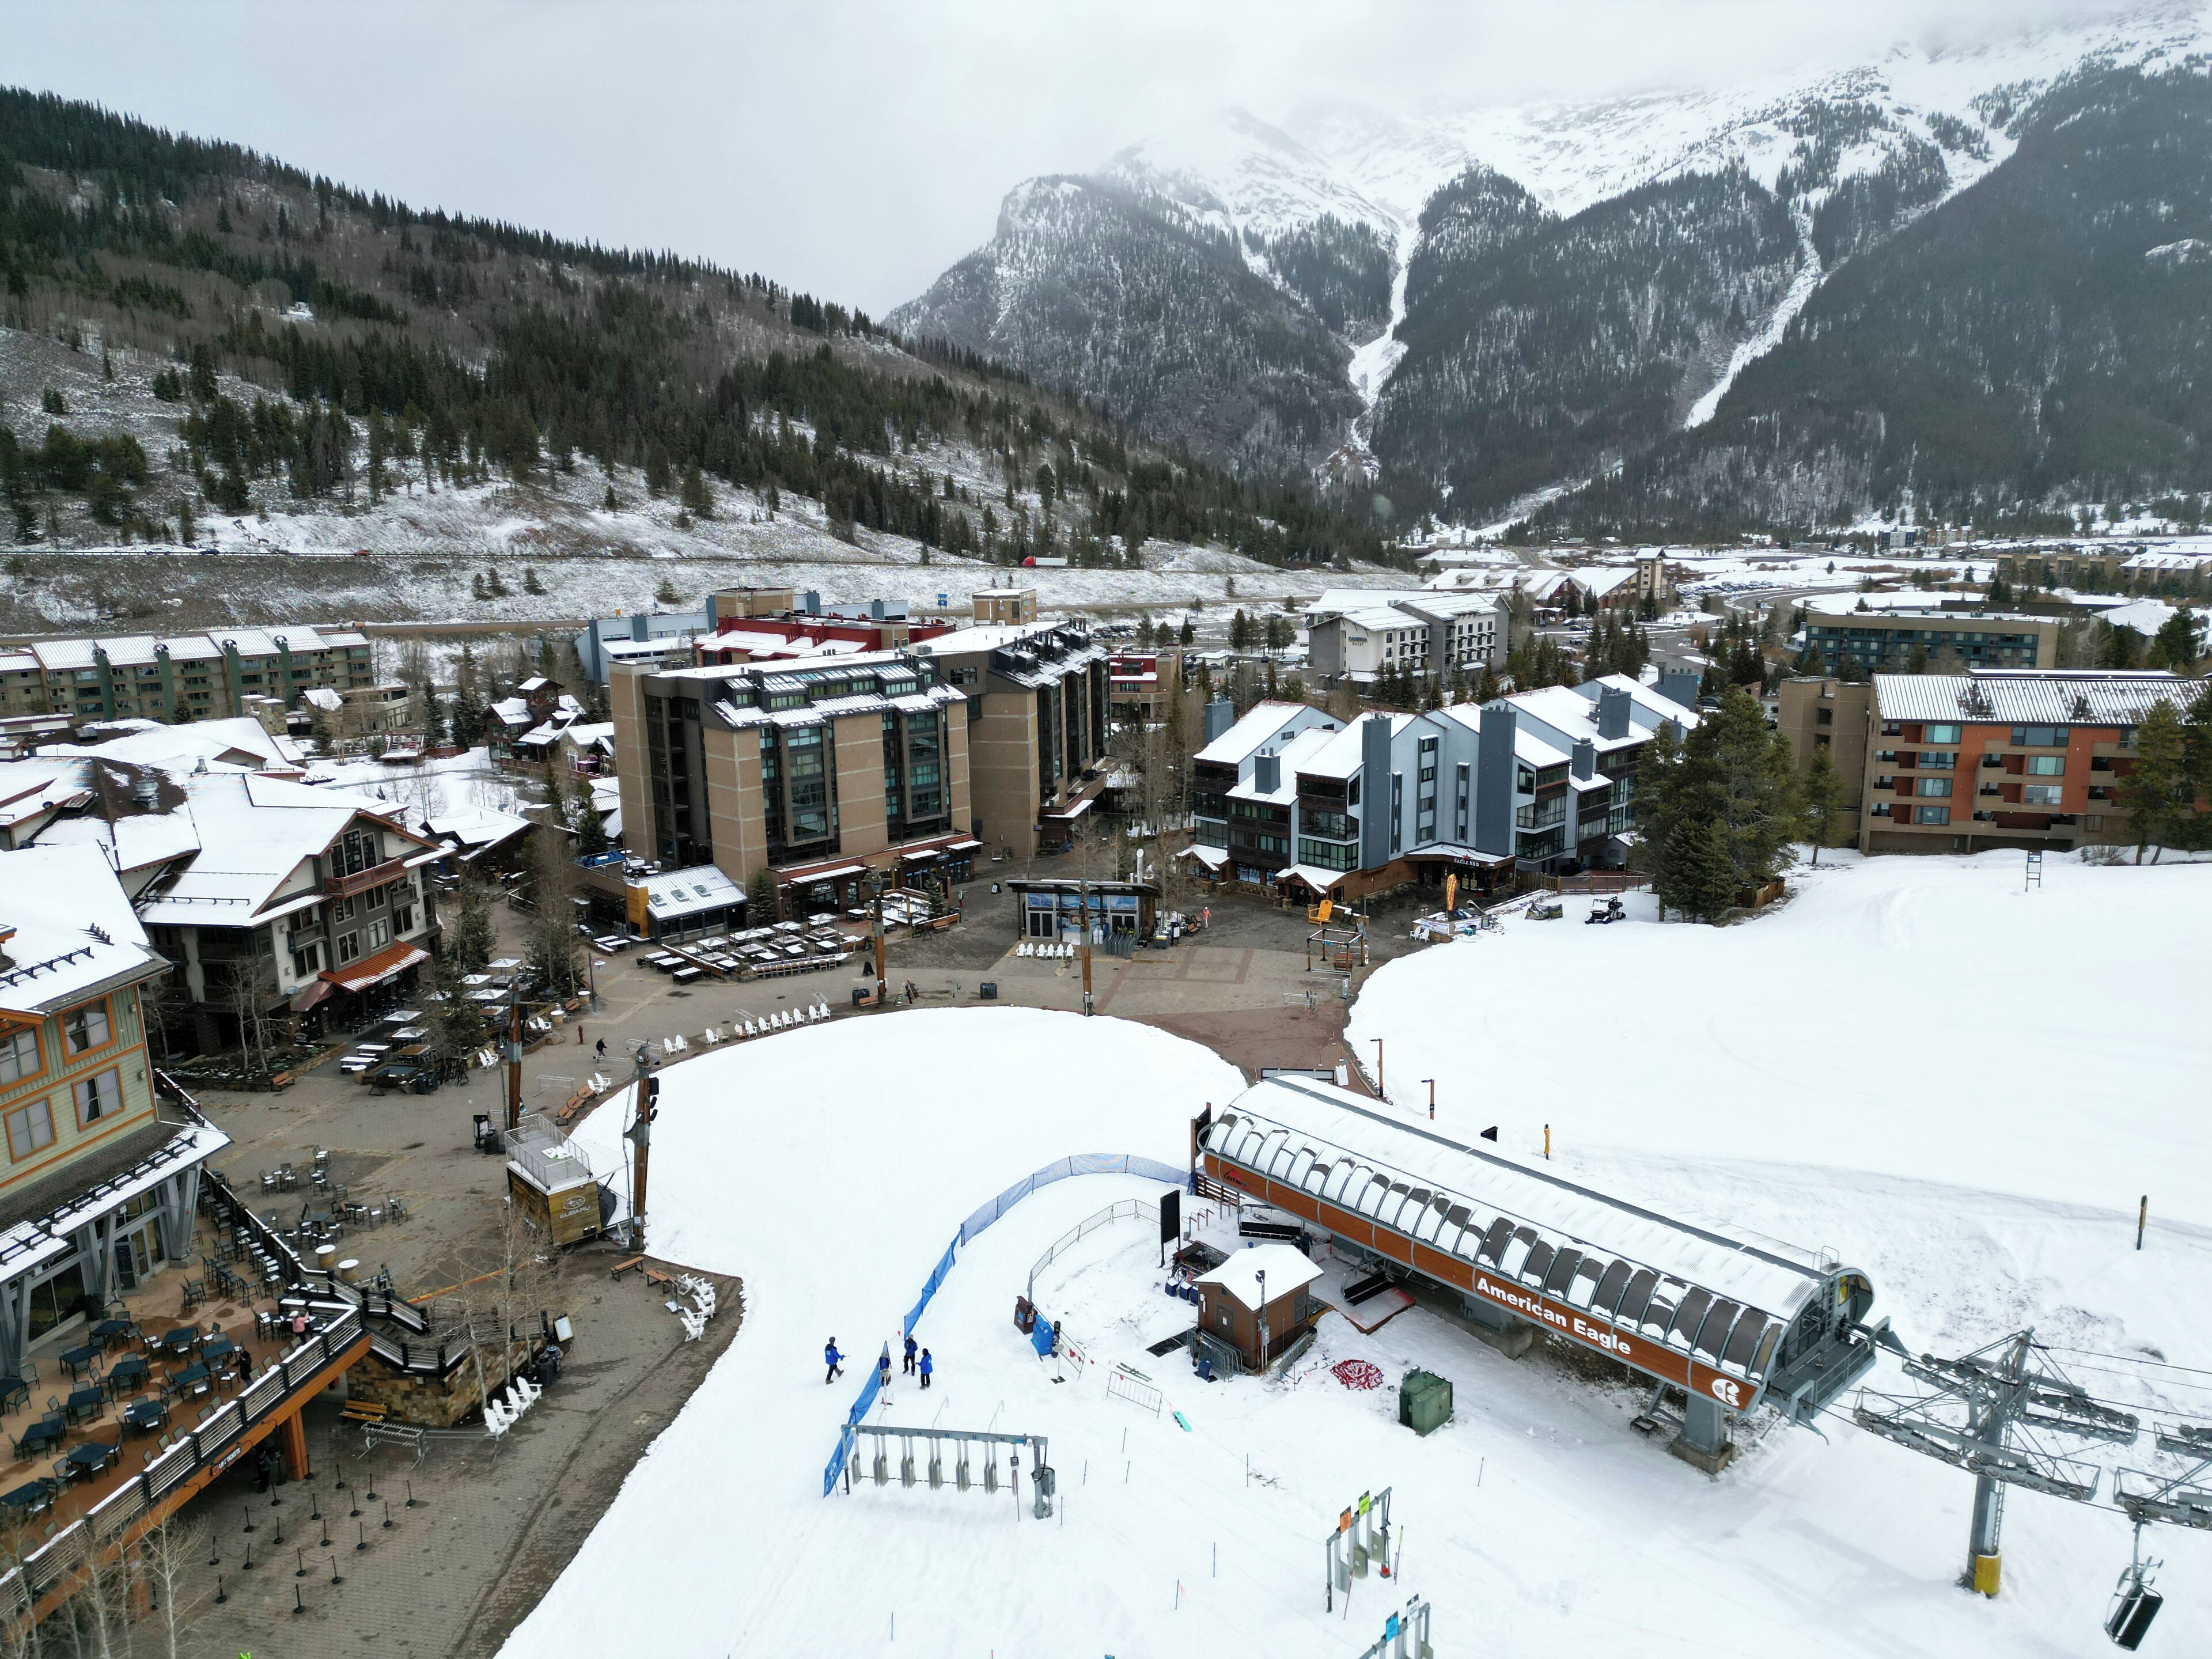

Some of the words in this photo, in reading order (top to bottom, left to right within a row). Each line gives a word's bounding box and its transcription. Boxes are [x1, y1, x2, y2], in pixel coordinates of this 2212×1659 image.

[559, 1205, 590, 1219] SUBARU
[1477, 1277, 1567, 1328] American
[1573, 1317, 1631, 1355] Eagle
